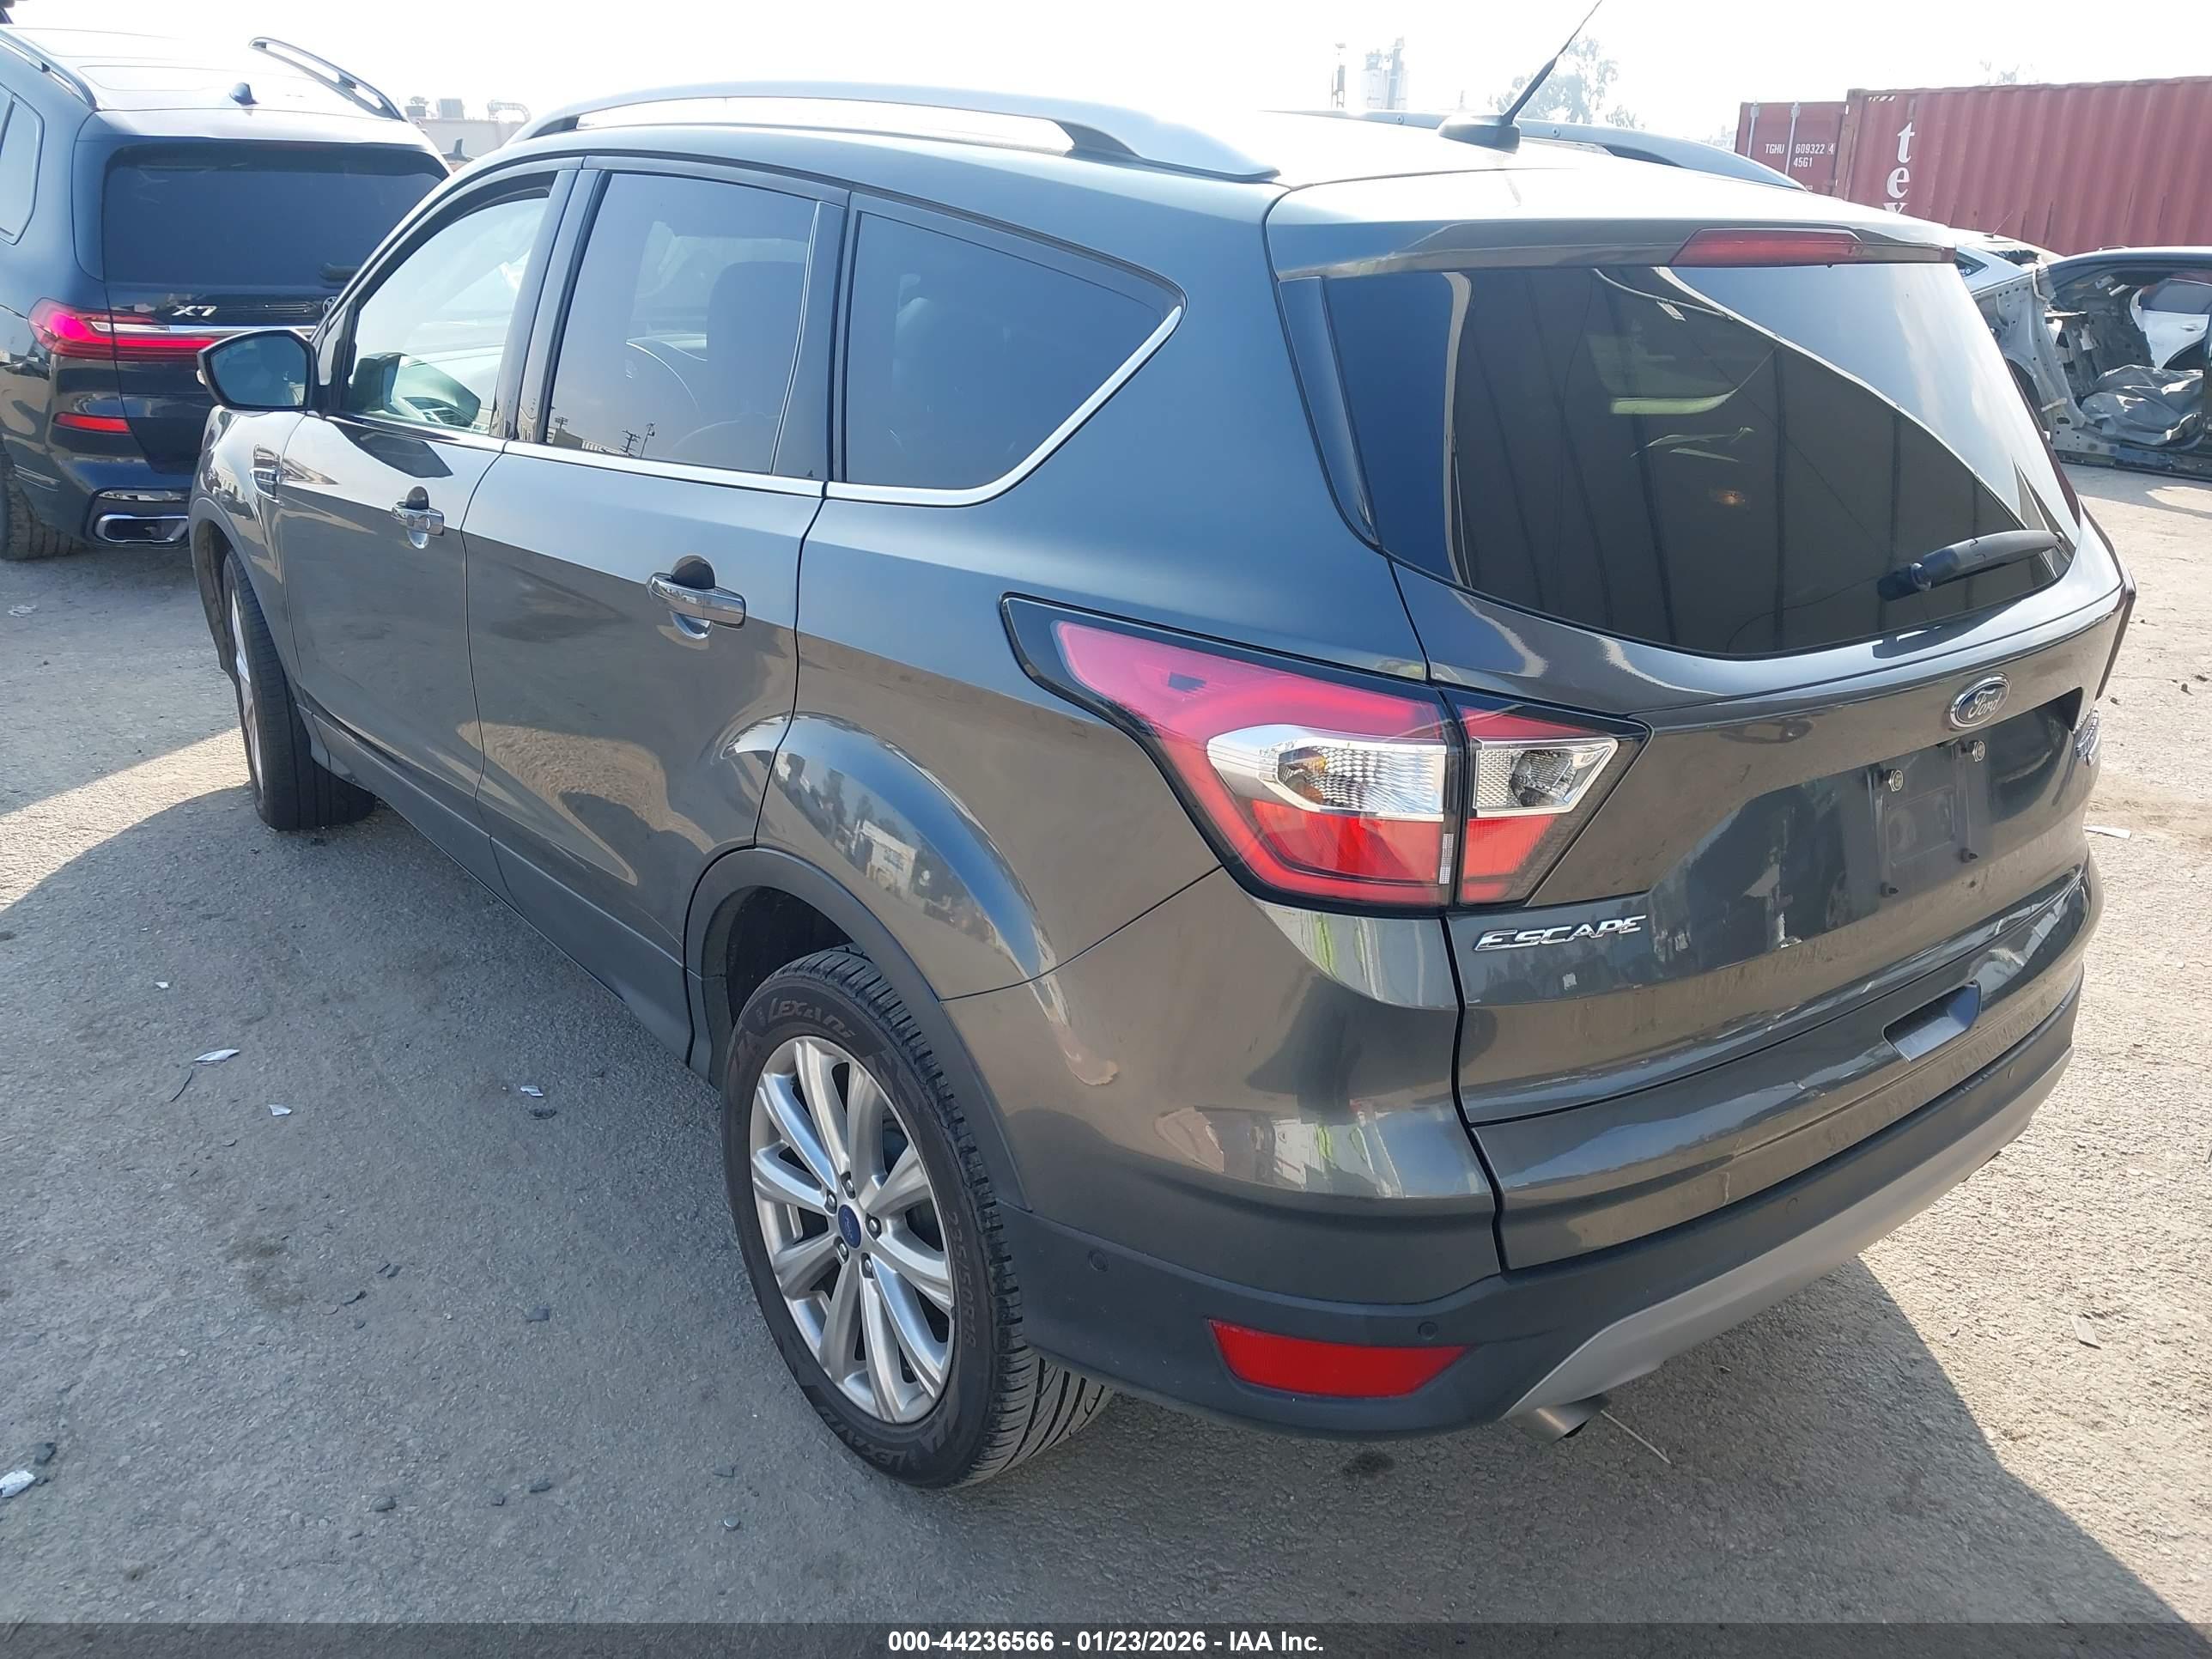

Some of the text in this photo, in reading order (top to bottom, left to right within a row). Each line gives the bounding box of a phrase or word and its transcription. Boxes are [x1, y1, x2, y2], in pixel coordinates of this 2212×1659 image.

[1765, 143, 1836, 155] TGHU 609322 4
[1793, 157, 1813, 167] 45G1
[172, 305, 217, 317] X7
[1967, 687, 2002, 720] Ford
[1474, 914, 1647, 951] ESCAPE
